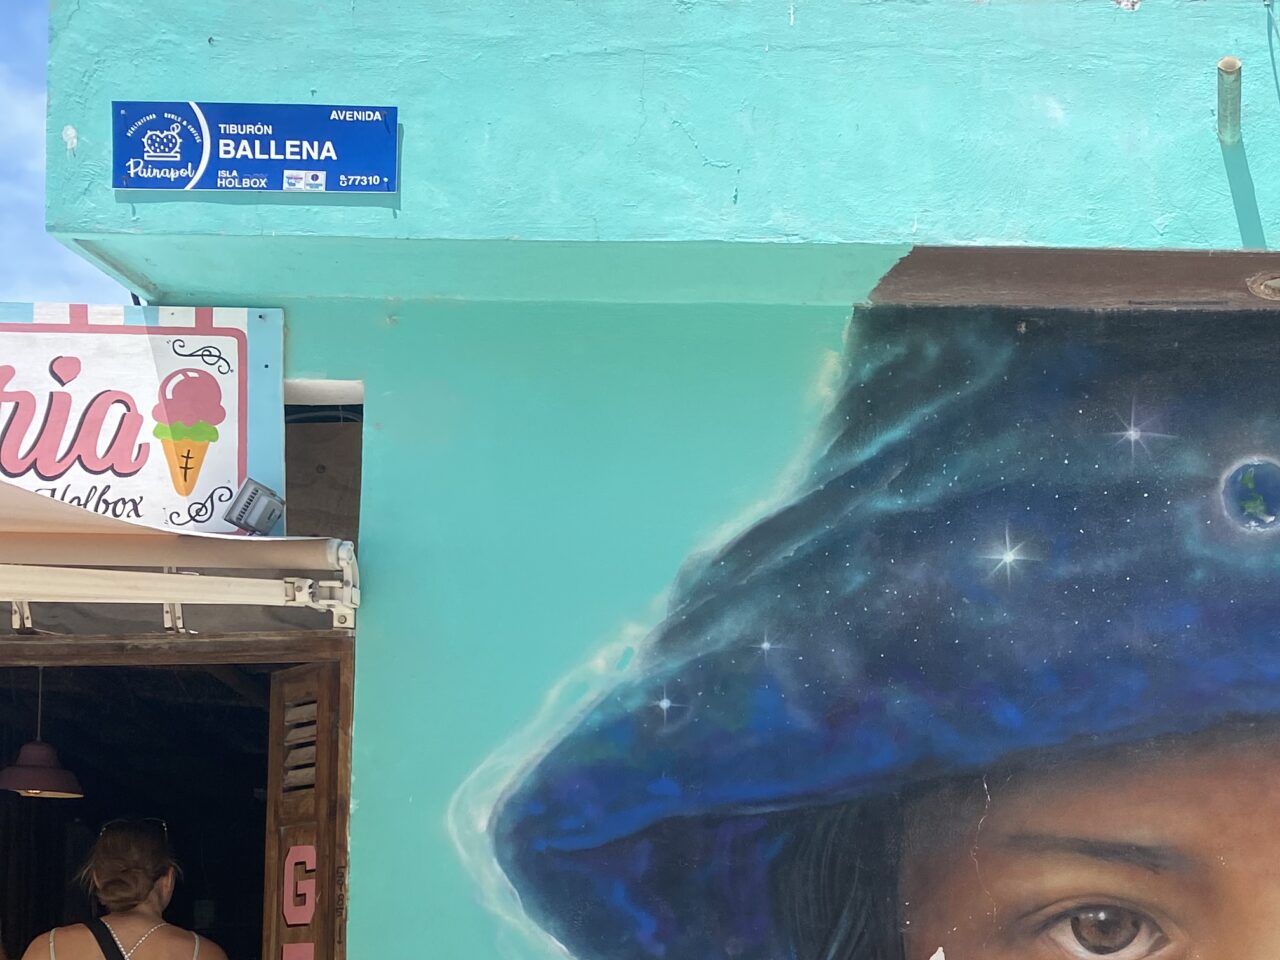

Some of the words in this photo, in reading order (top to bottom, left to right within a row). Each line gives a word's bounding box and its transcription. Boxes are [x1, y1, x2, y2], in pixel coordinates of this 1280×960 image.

[330, 110, 382, 121] AVENIDA
[218, 122, 272, 135] TIBURÓN
[218, 139, 337, 160] BALLENA
[218, 169, 238, 178] ISLA
[217, 178, 268, 188] HOLBOX
[347, 175, 380, 186] 77310
